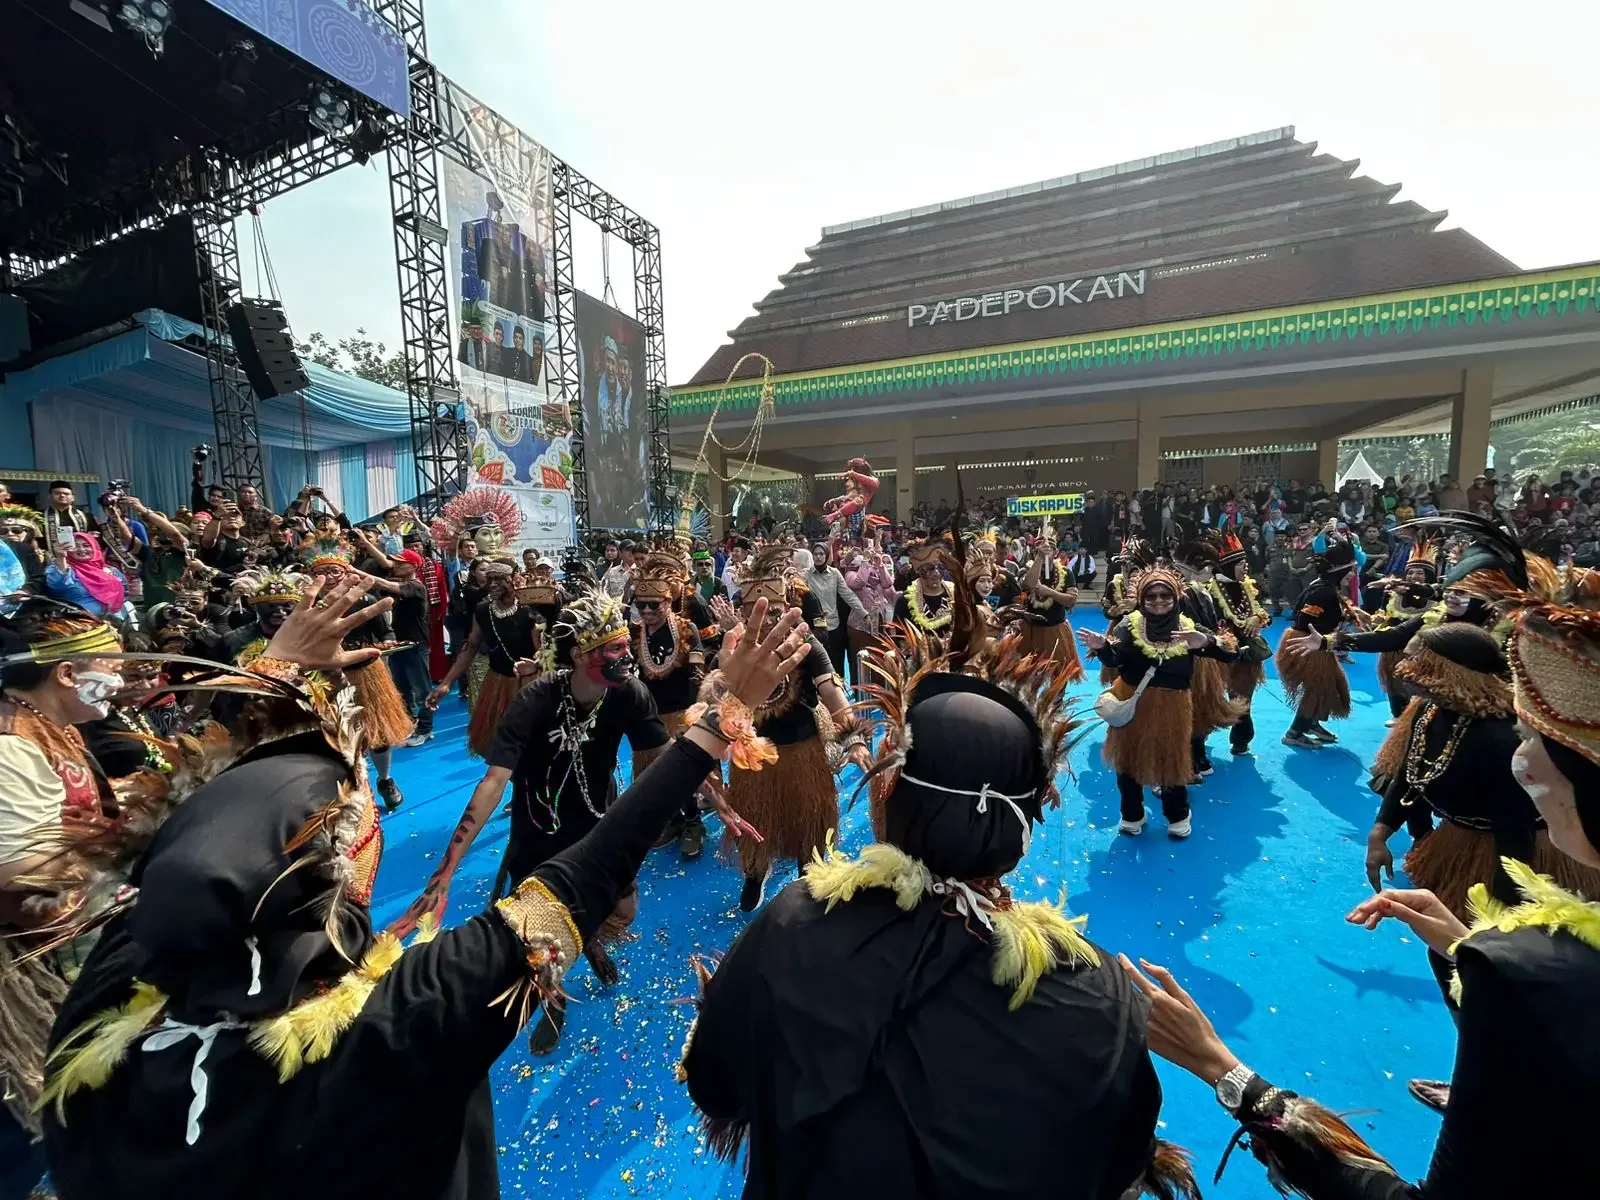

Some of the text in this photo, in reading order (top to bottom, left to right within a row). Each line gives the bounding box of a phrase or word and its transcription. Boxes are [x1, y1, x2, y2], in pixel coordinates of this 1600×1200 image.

[908, 269, 1146, 328] PADEPOKAN
[1030, 482, 1056, 490] KOTA
[1008, 498, 1083, 514] DISKARPUS
